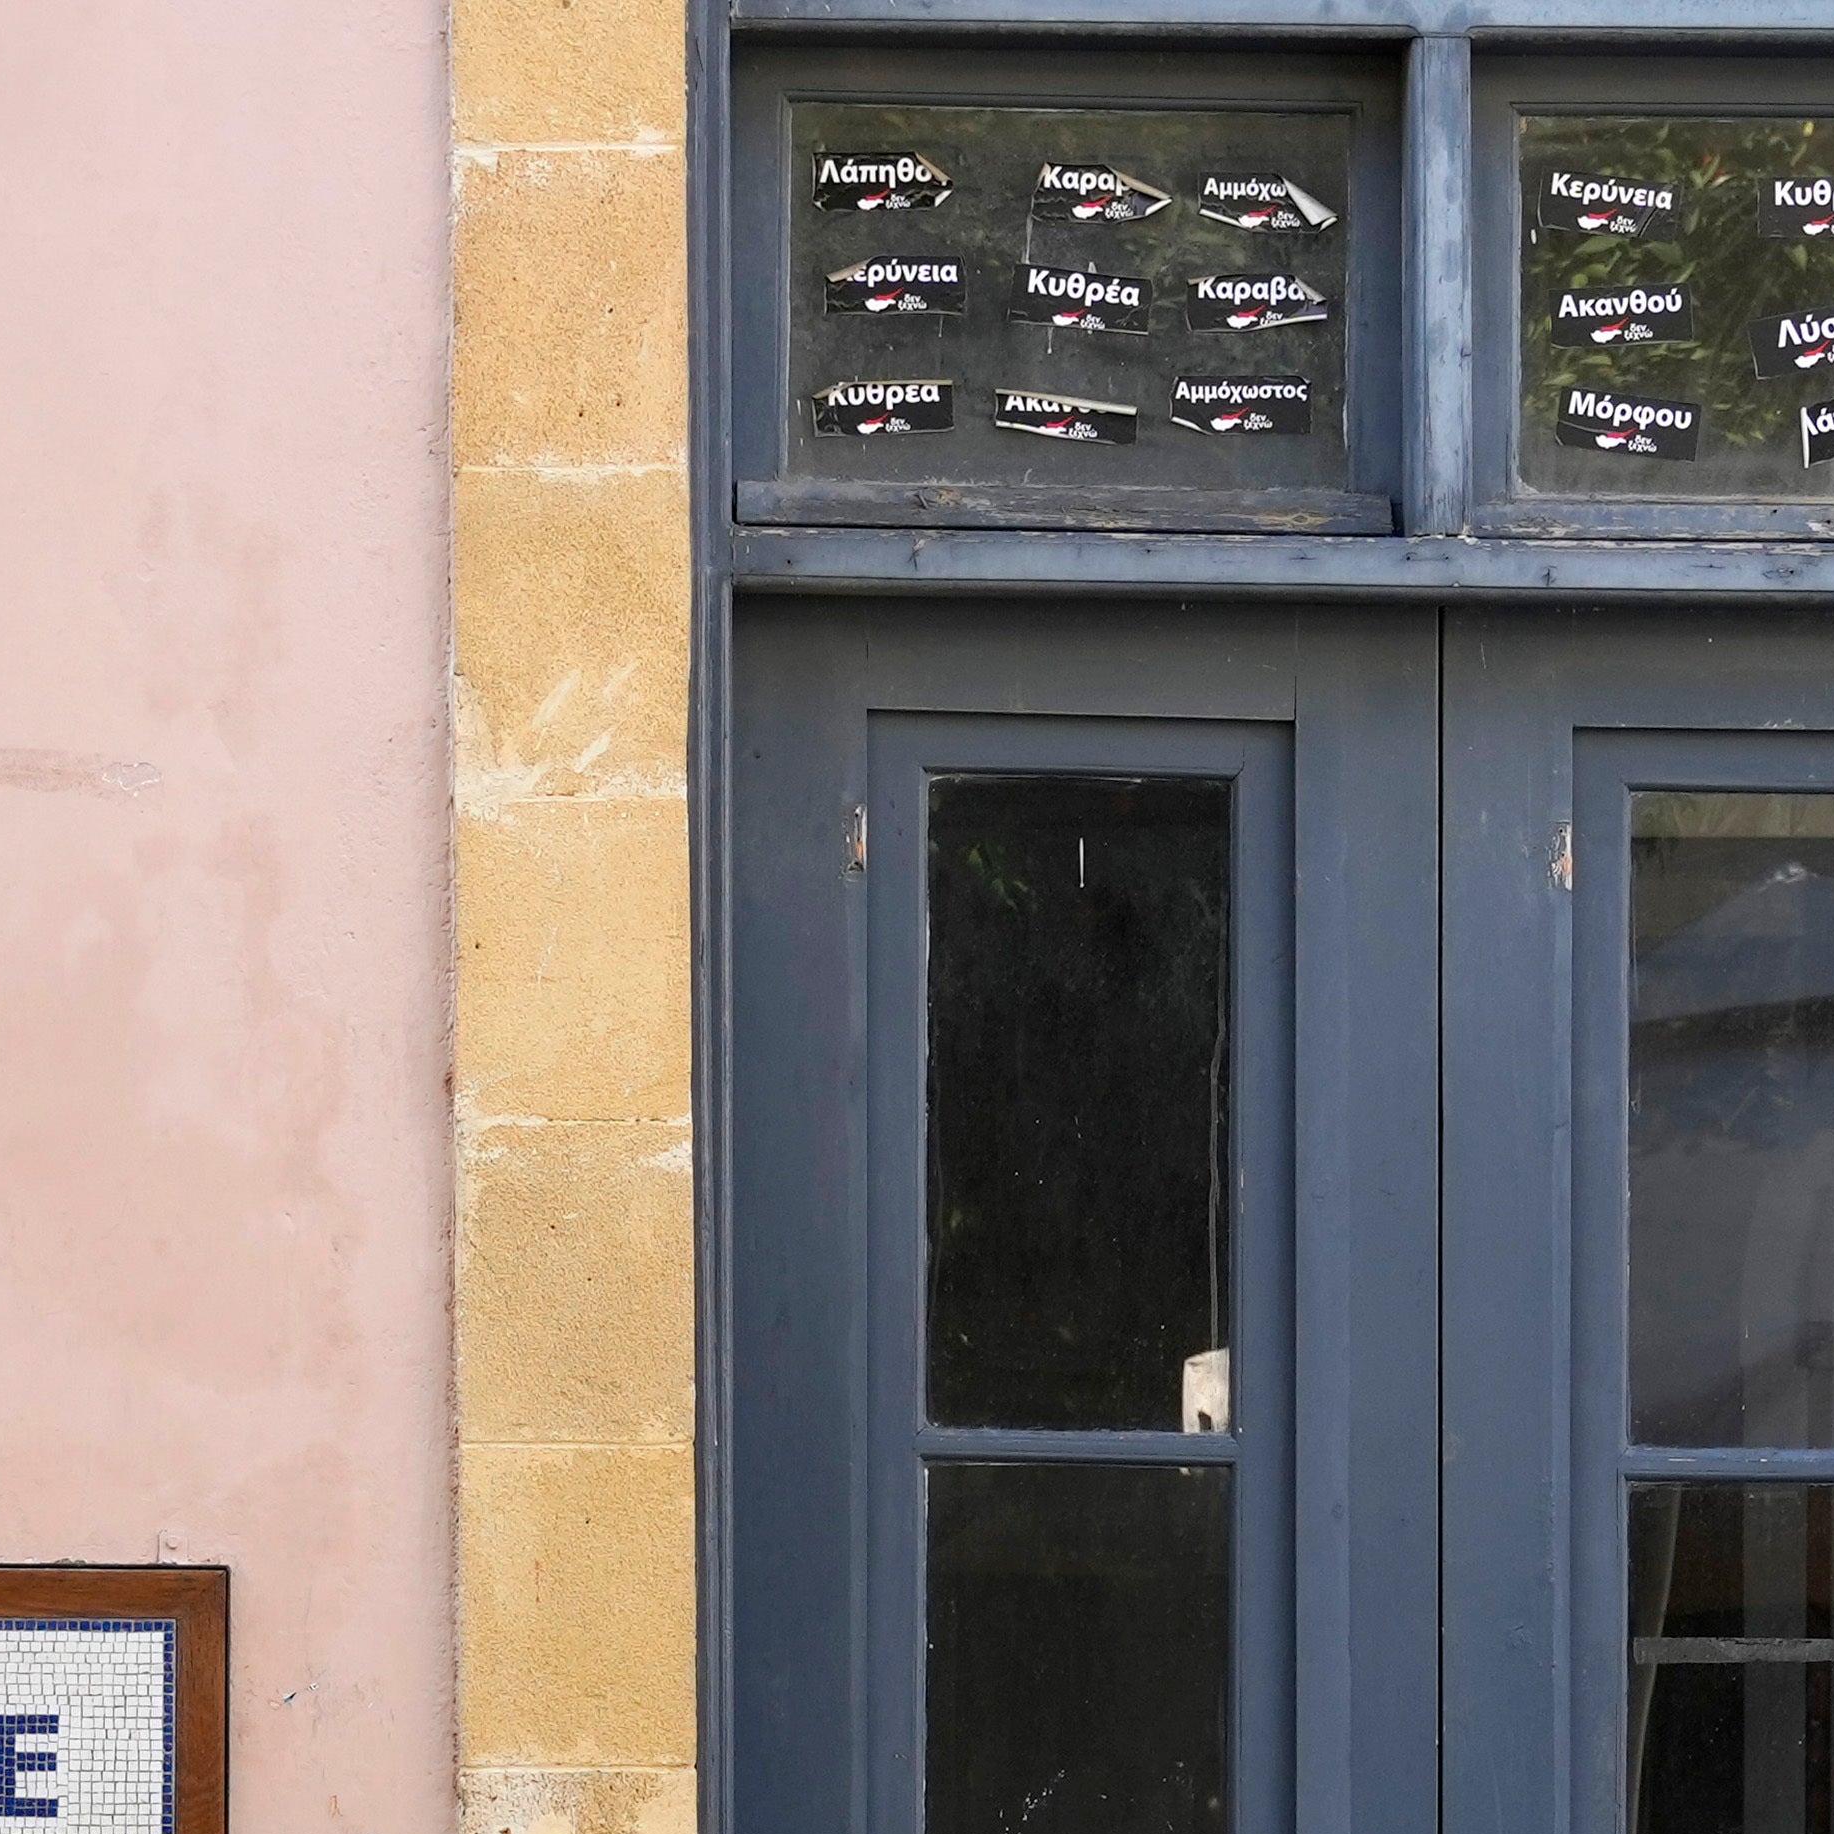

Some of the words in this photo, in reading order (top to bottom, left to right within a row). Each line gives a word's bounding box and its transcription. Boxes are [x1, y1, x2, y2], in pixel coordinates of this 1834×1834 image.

[820, 159, 947, 188] Λάπηθο
[1204, 177, 1287, 201] Αμμόχω
[1551, 173, 1672, 209] Κερύνεια
[847, 260, 958, 286] ερύνεια
[1027, 269, 1140, 306] Κυθρέα
[1558, 288, 1682, 318] Ακανθού
[1176, 382, 1307, 403] Αμμόχωστος
[1568, 391, 1692, 429] Μόρφου
